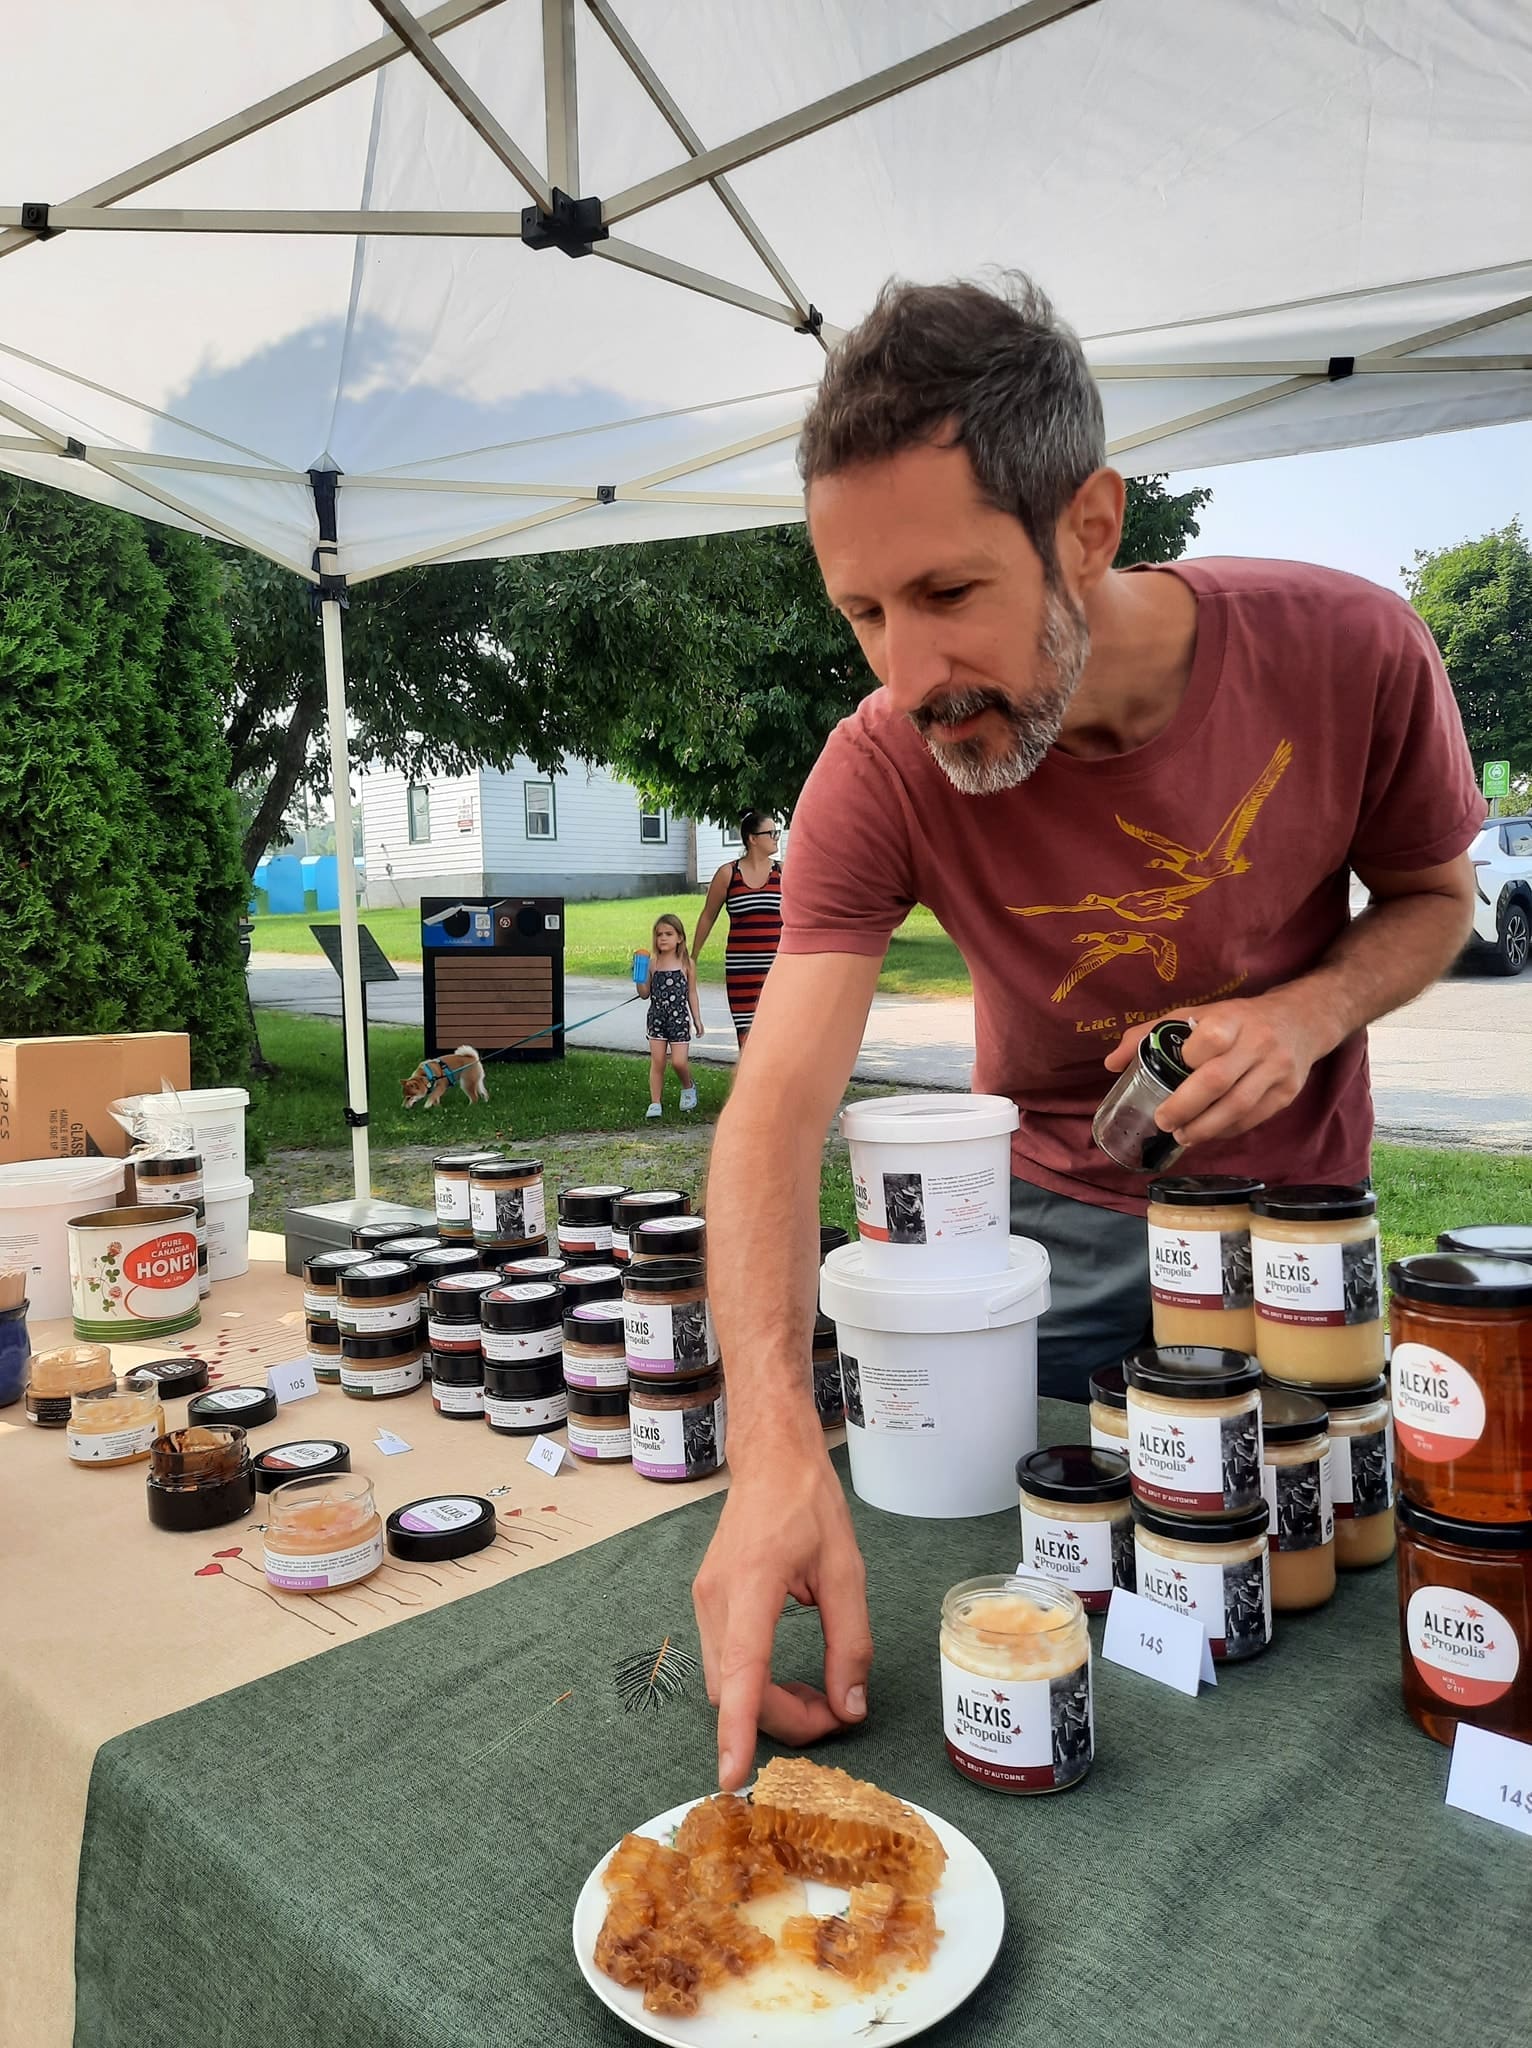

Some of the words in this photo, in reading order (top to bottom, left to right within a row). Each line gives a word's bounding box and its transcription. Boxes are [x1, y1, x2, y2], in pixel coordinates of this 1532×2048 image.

[1075, 1016, 1117, 1033] Lac
[49, 1109, 58, 1123] THIS
[50, 1125, 58, 1140] SIDE
[71, 1122, 84, 1156] GLASS
[151, 1244, 190, 1258] CANADIAN
[161, 1238, 182, 1249] PURE
[136, 1250, 196, 1280] HONEY
[1156, 1246, 1191, 1266] ALEXIS
[1266, 1262, 1311, 1282] ALEXIS
[1271, 1280, 1312, 1294] Propolis
[289, 1378, 306, 1391] 10$
[1400, 1369, 1449, 1399] ALEXIS
[1404, 1393, 1451, 1415] Propolis
[633, 1423, 660, 1441] ALEXIS
[1139, 1431, 1186, 1459] ALEXIS
[1144, 1453, 1187, 1472] Propolis
[1035, 1536, 1080, 1561] ALEXIS
[1040, 1556, 1081, 1573] Propolis
[1144, 1572, 1188, 1603] ALEXIS
[1424, 1610, 1485, 1644] ALEXIS
[1140, 1632, 1163, 1655] 14$
[1430, 1634, 1486, 1659] Propolis
[957, 1694, 1011, 1729] ALEXIS
[963, 1719, 1013, 1745] Propolis
[955, 1754, 966, 1767] MIEL
[967, 1762, 983, 1775] BRUT
[984, 1769, 1025, 1781] D'AUTOMNE
